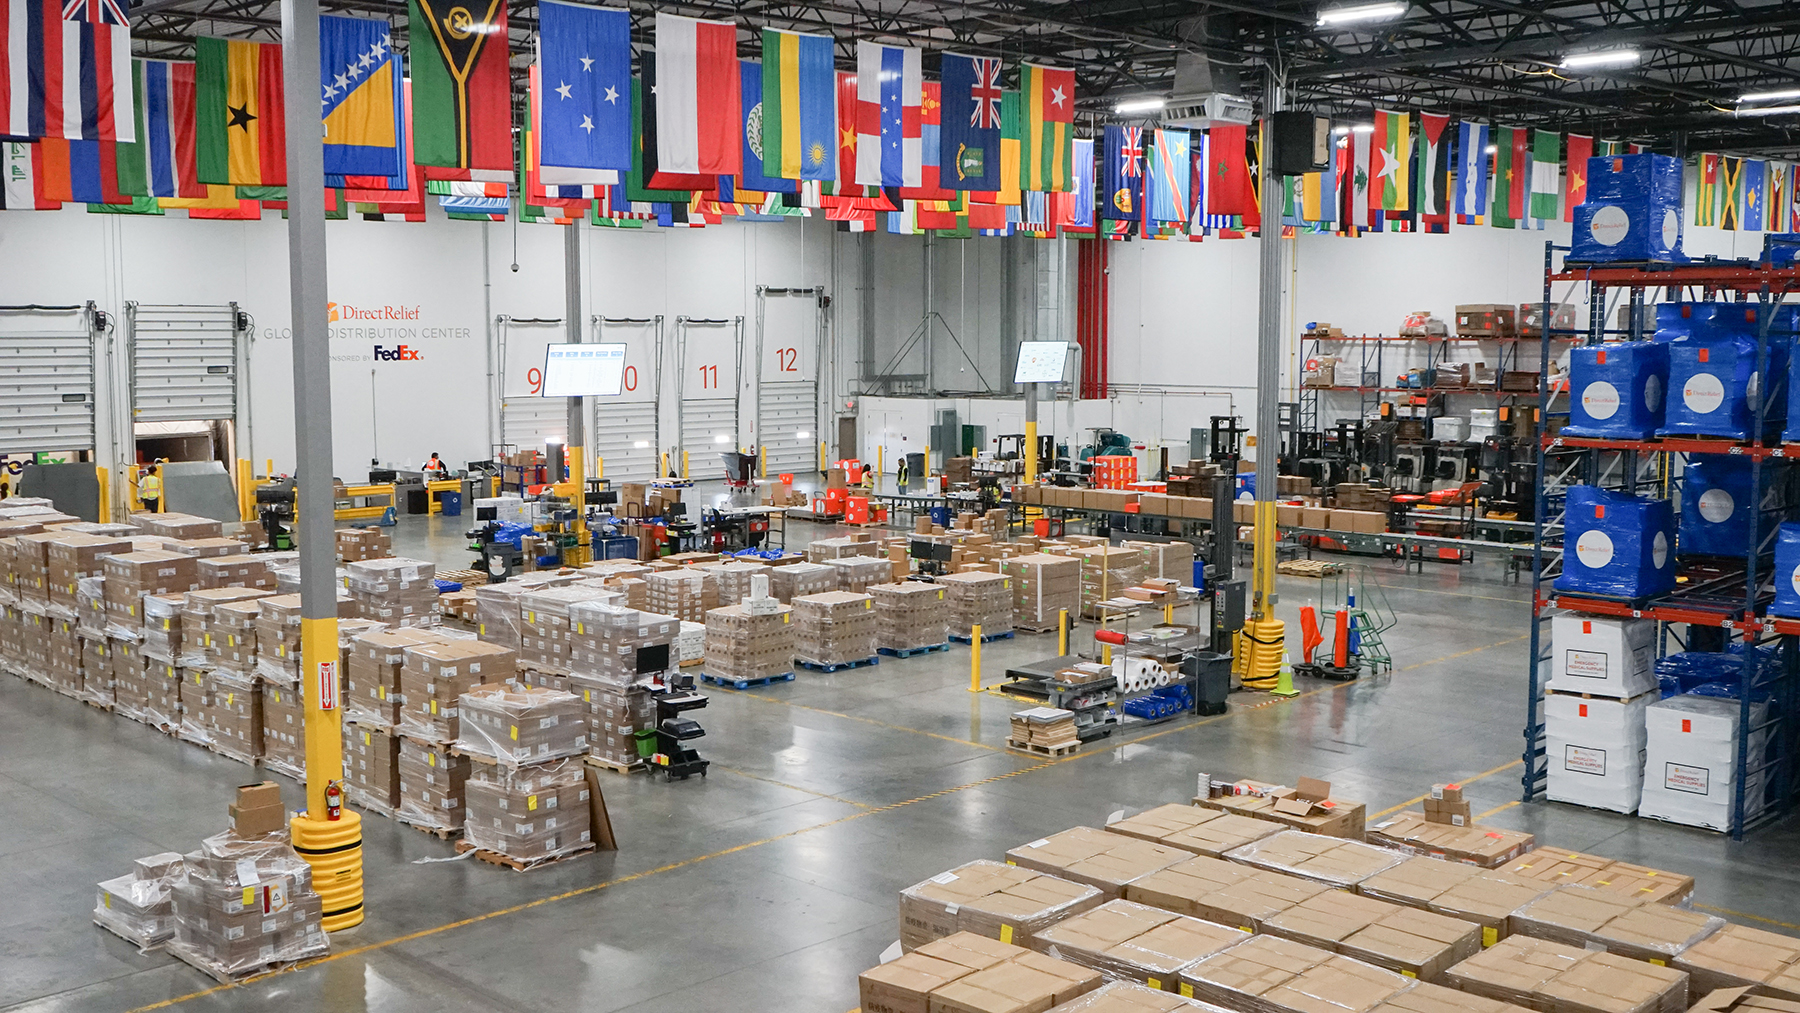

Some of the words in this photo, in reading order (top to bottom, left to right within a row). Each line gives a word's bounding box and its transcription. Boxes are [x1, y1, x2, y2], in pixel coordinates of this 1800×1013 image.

[263, 327, 292, 339] GLO
[421, 327, 471, 339] CENTER
[373, 345, 420, 361] FedEx
[776, 347, 798, 372] 12
[527, 367, 542, 394] 9
[624, 365, 638, 392] 0
[699, 365, 718, 389] 11
